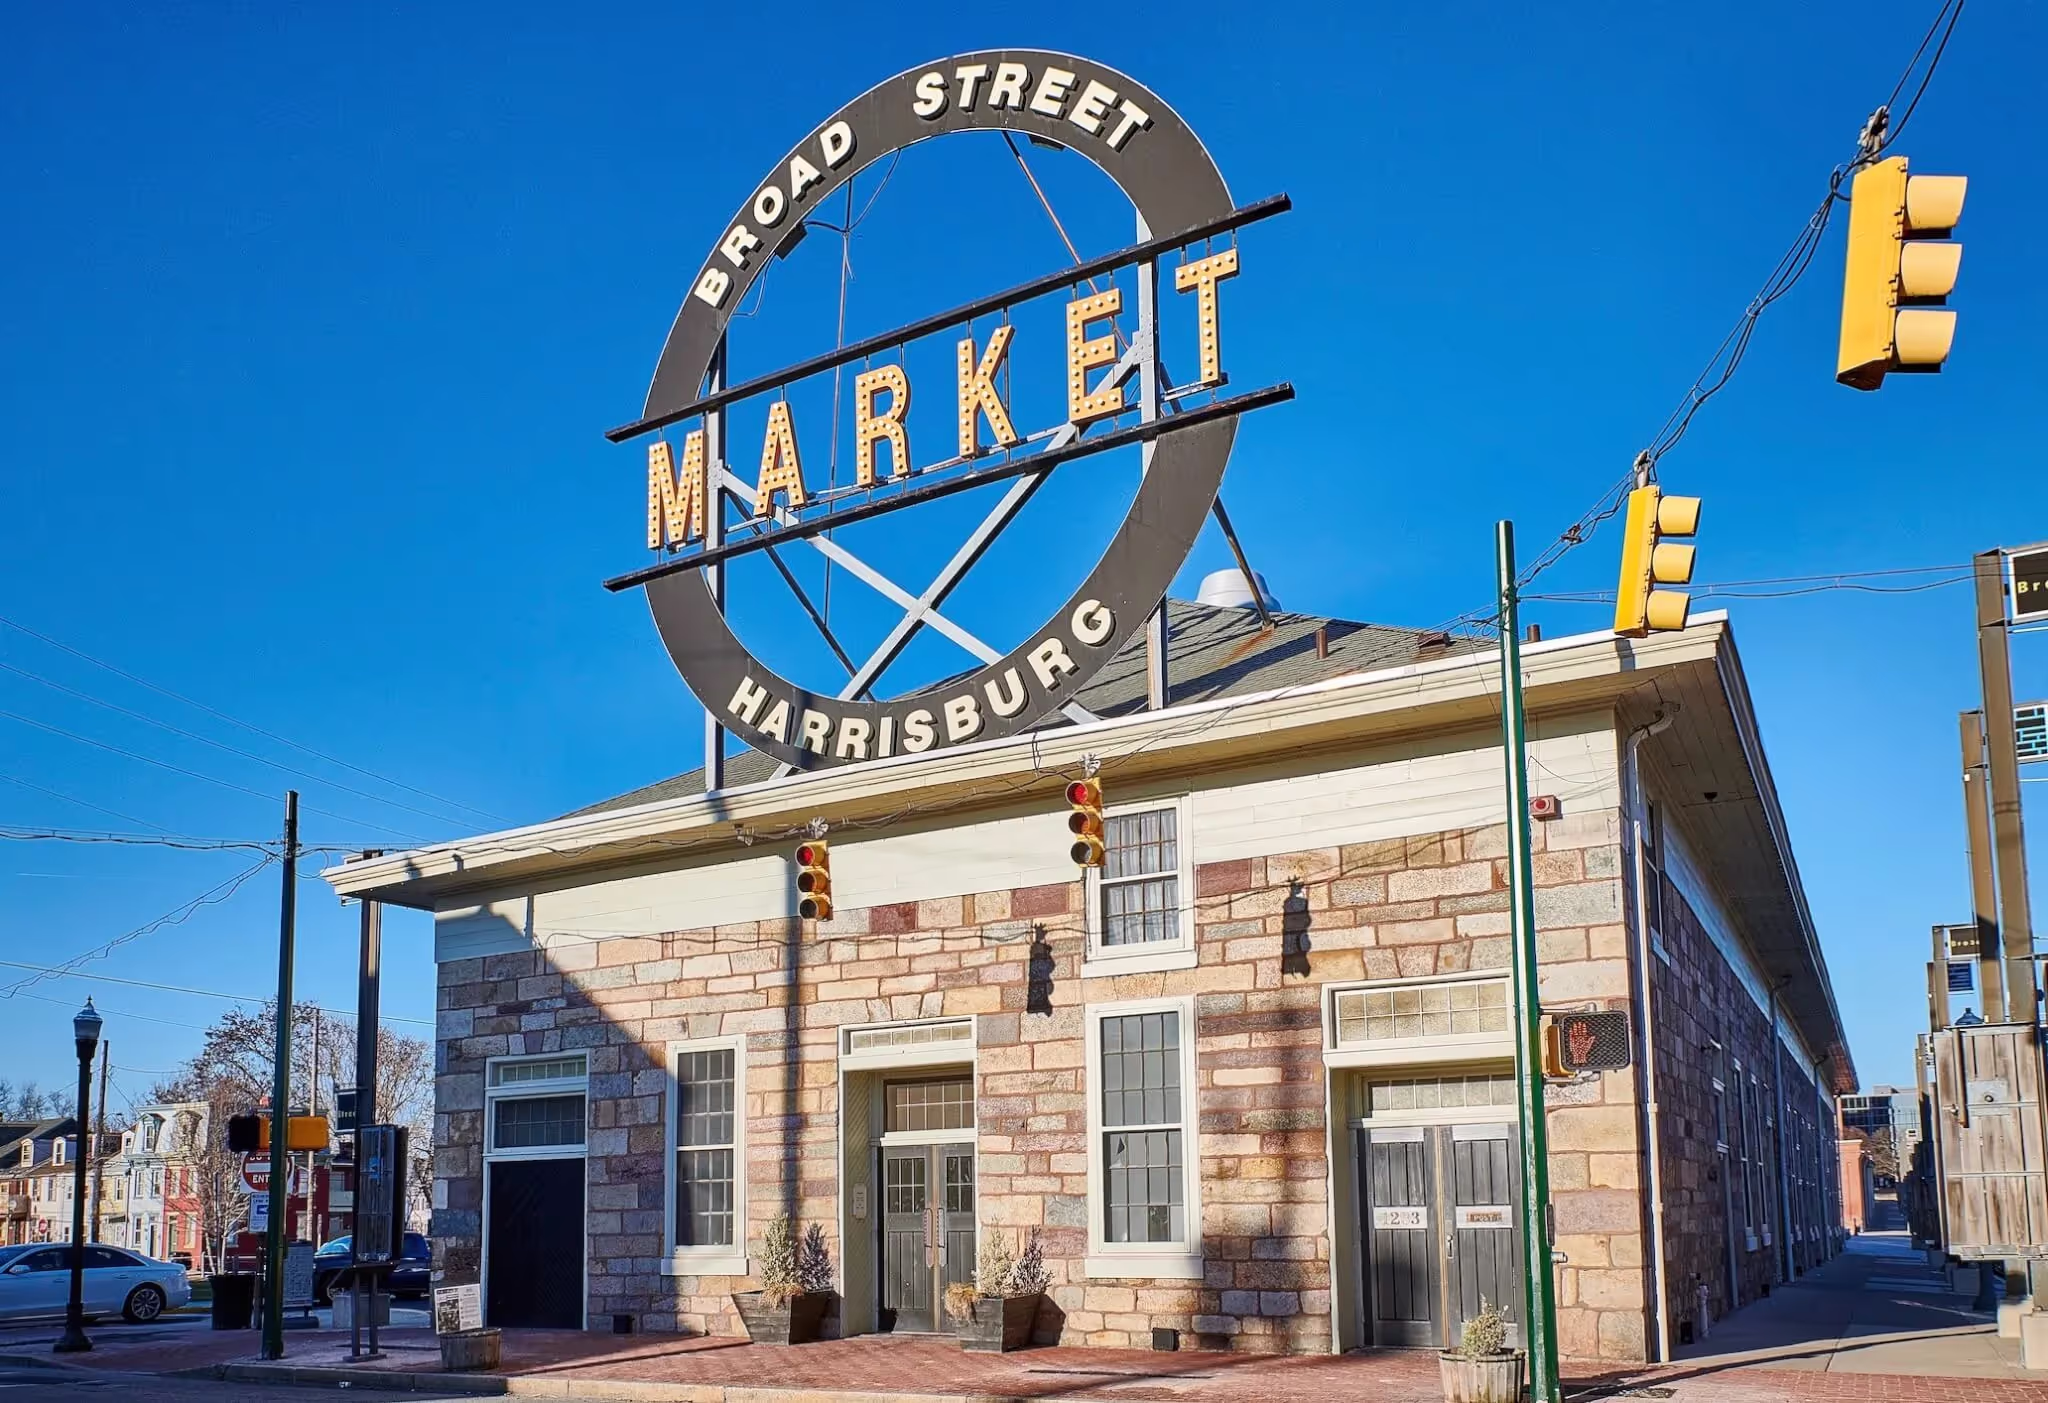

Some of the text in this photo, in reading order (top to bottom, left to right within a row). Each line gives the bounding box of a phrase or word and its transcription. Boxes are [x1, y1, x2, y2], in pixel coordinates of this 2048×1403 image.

[694, 62, 1152, 308] BROAD STREET
[647, 249, 1239, 550] MARKET
[727, 599, 1115, 759] HARRISBURG
[252, 1174, 270, 1184] ENT
